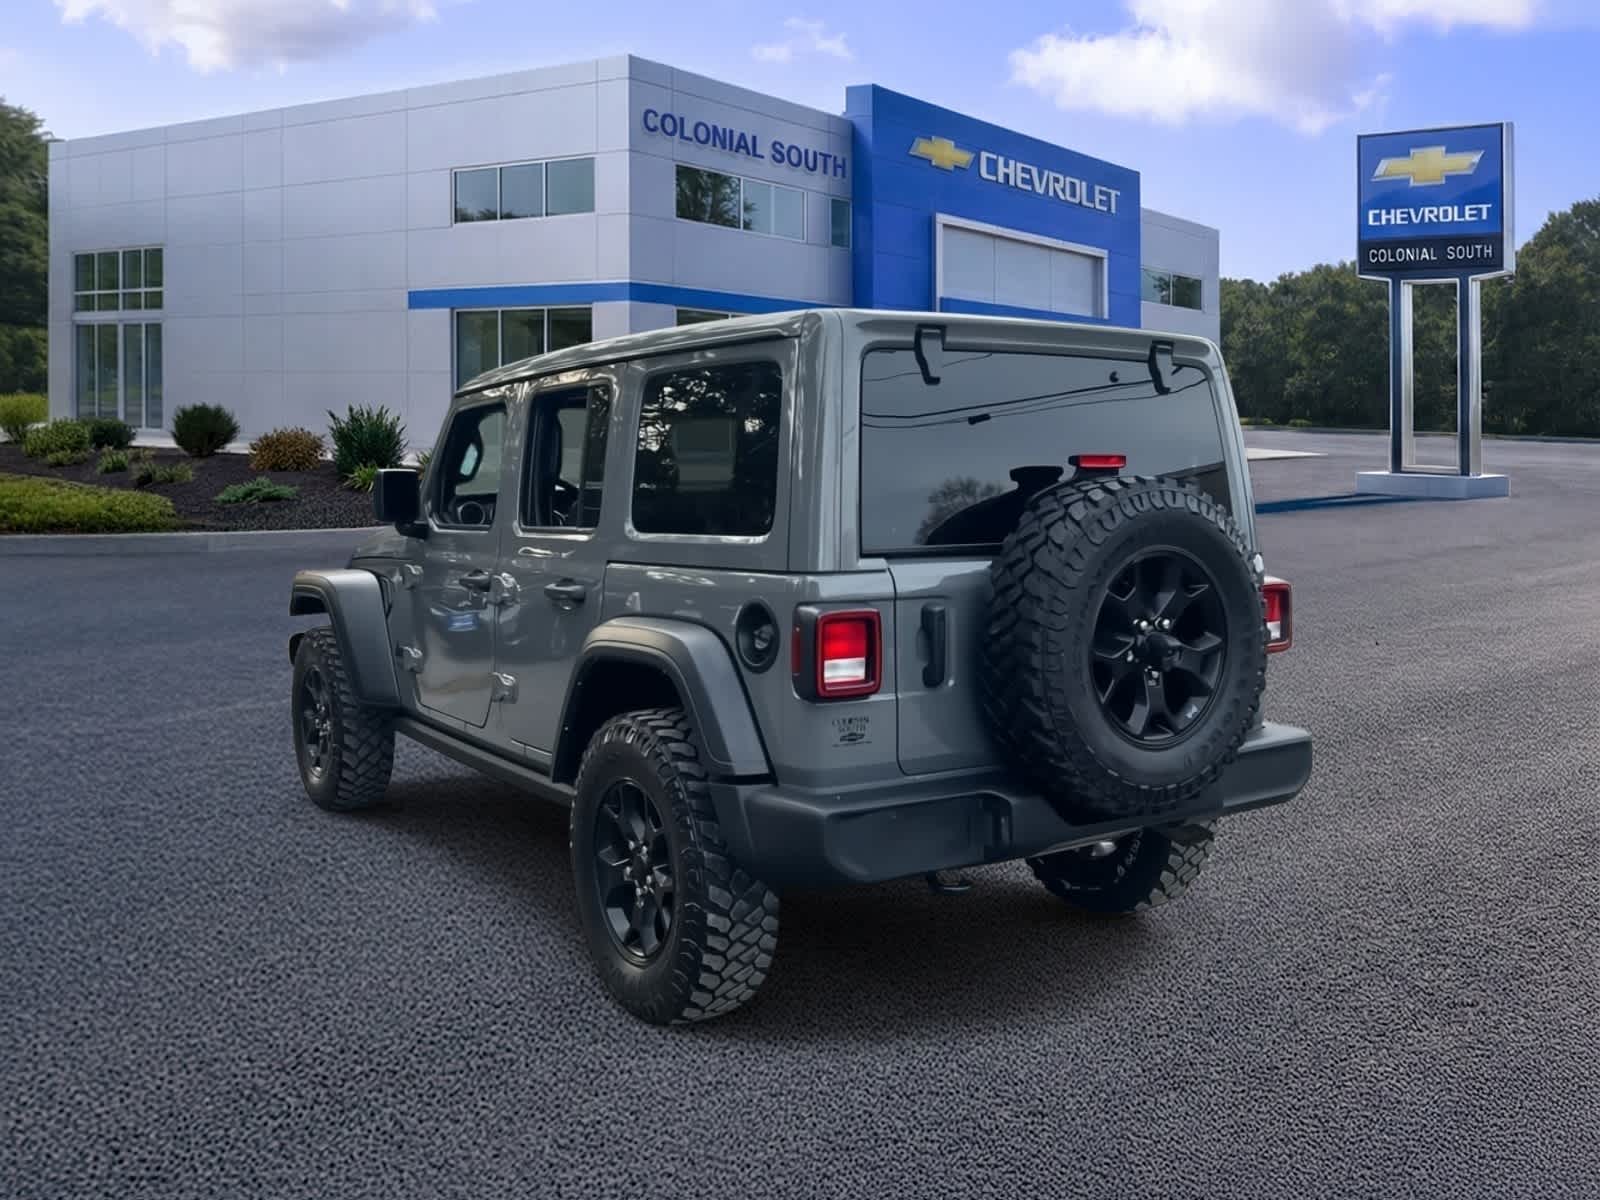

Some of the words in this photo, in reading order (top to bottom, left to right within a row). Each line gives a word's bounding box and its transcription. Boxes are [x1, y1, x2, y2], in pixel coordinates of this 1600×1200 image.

[643, 109, 765, 159] COLONIAL
[771, 141, 847, 179] SOUTH
[979, 151, 1121, 214] CHEVROLET
[1368, 204, 1492, 226] CHEVROLET
[1369, 248, 1438, 263] COLONIAL
[1447, 244, 1493, 260] SOUTH
